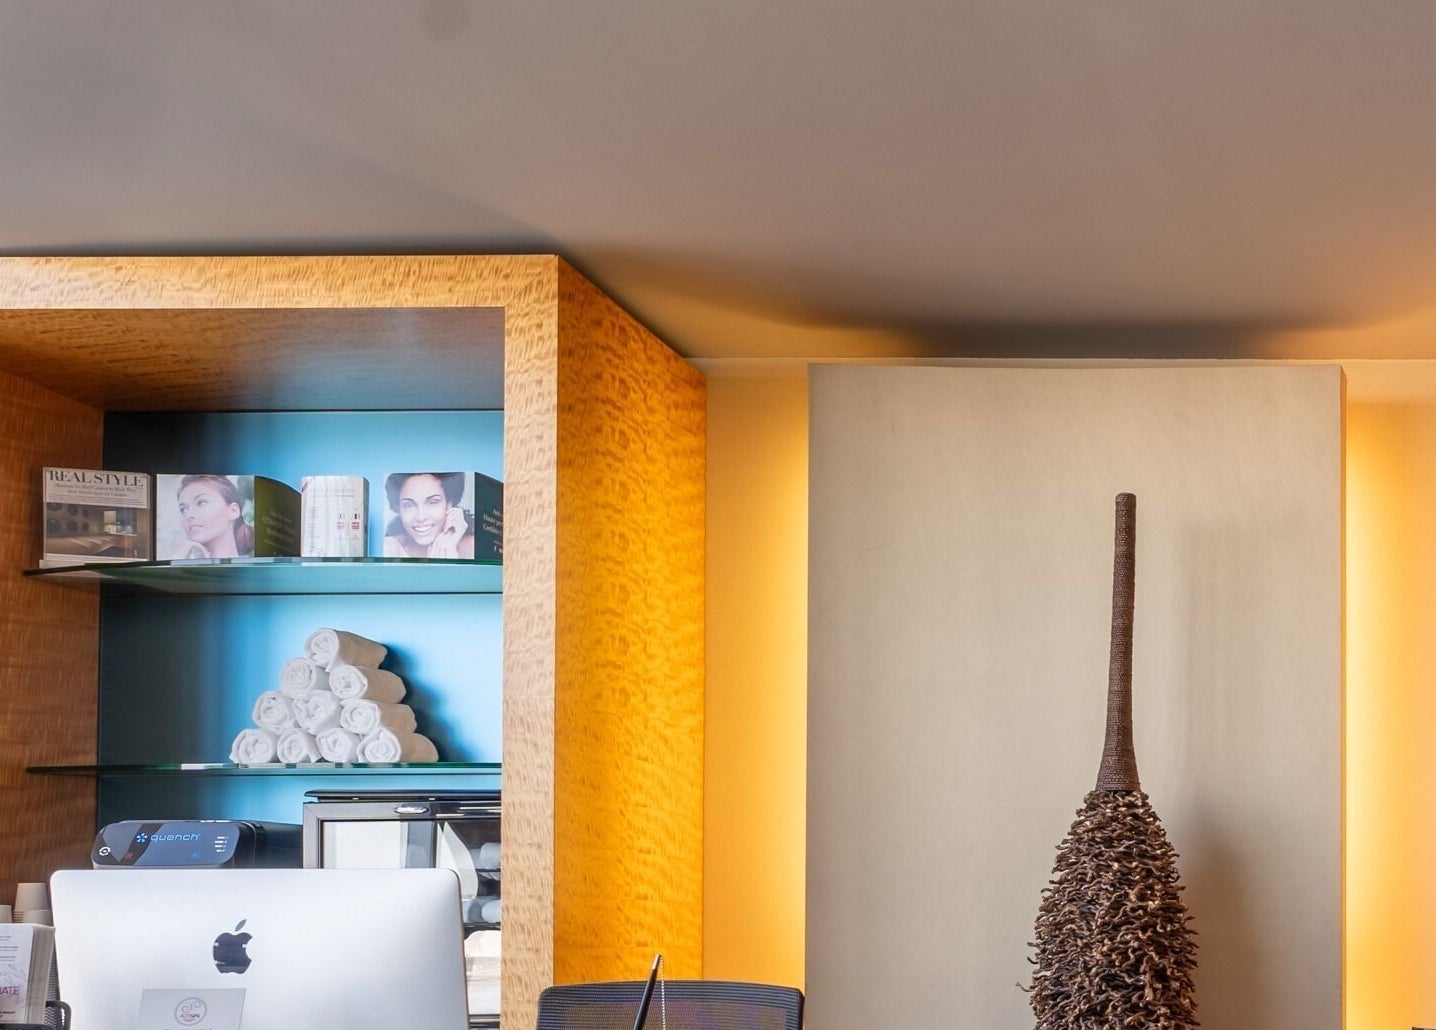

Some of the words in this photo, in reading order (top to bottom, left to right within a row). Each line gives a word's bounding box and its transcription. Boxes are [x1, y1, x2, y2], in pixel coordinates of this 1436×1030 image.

[49, 470, 92, 483] REAL
[93, 473, 144, 488] STYLE
[150, 833, 199, 842] quench
